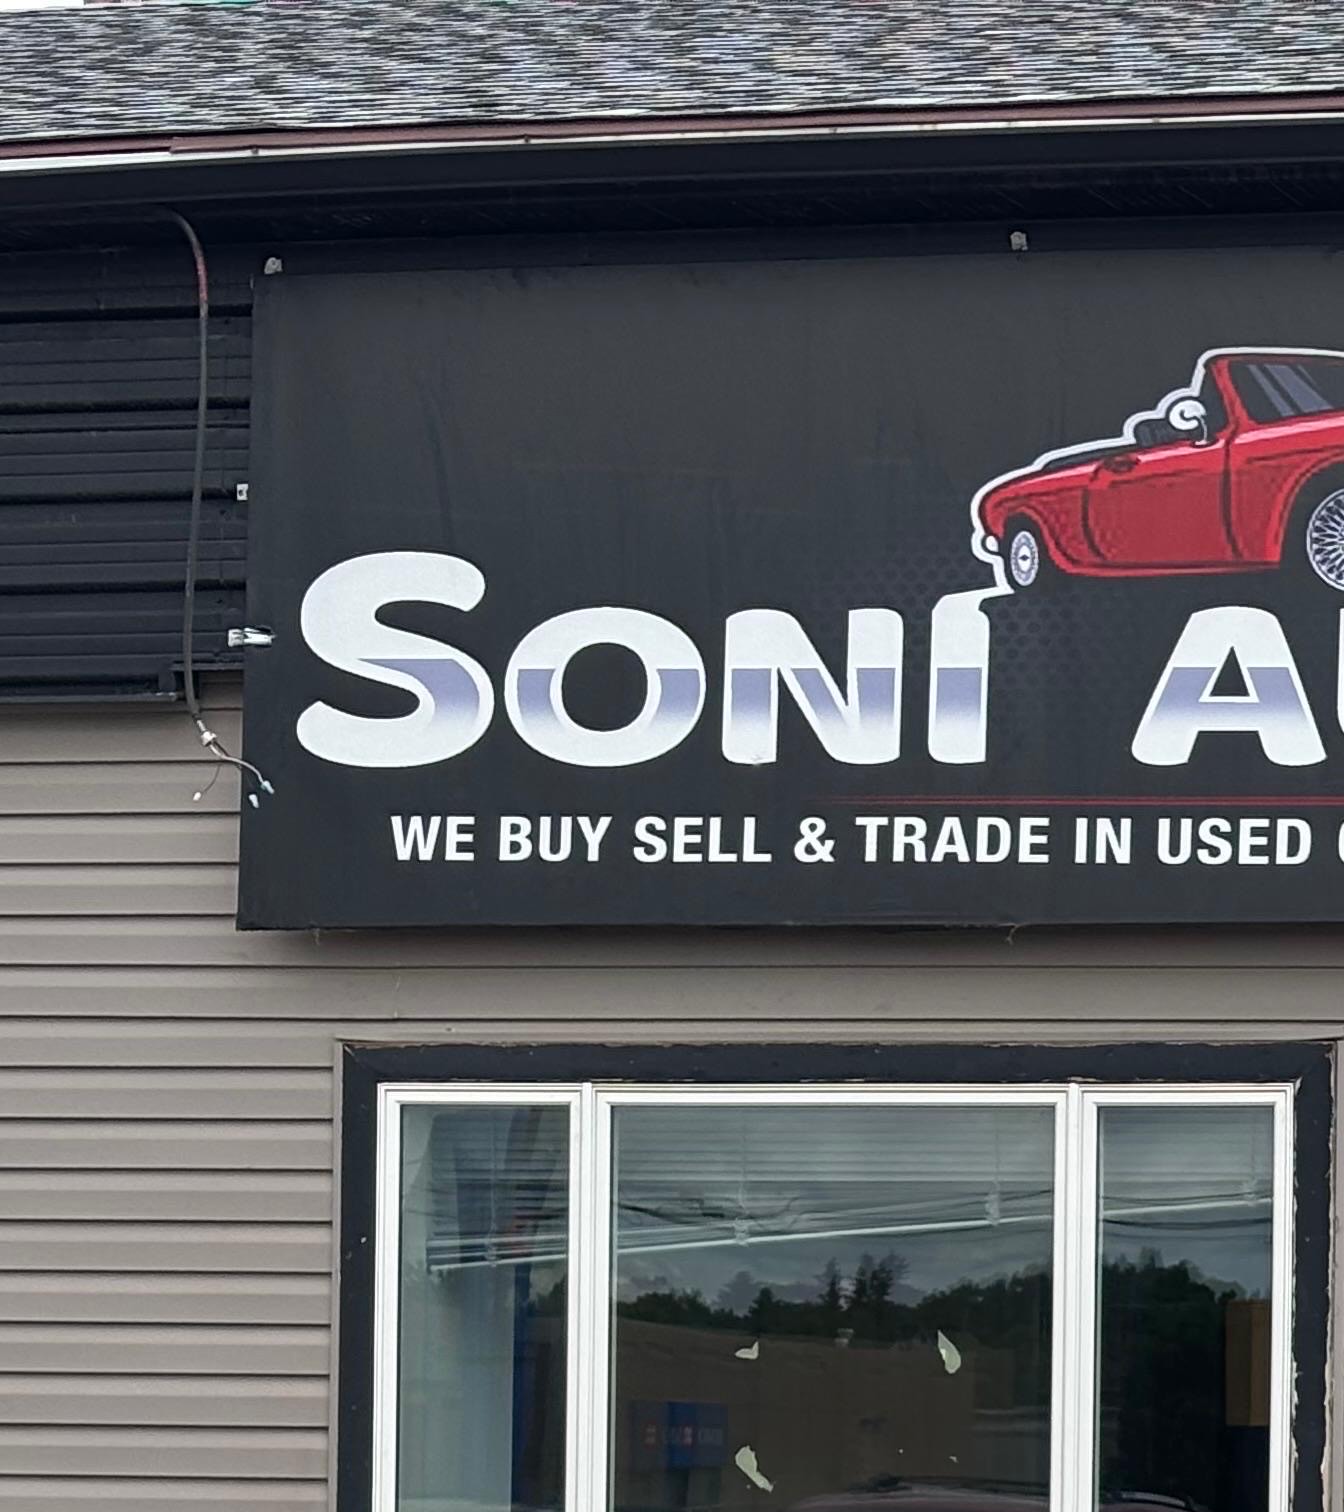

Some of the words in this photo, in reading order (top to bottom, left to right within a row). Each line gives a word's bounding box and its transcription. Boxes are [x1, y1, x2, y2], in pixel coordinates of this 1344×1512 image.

[391, 816, 475, 861] WE
[498, 816, 613, 862] BUY
[633, 816, 772, 863] SELL
[793, 816, 835, 863] &
[855, 816, 1050, 863] TRADE
[1074, 817, 1132, 864] IN
[1157, 817, 1312, 865] USED
